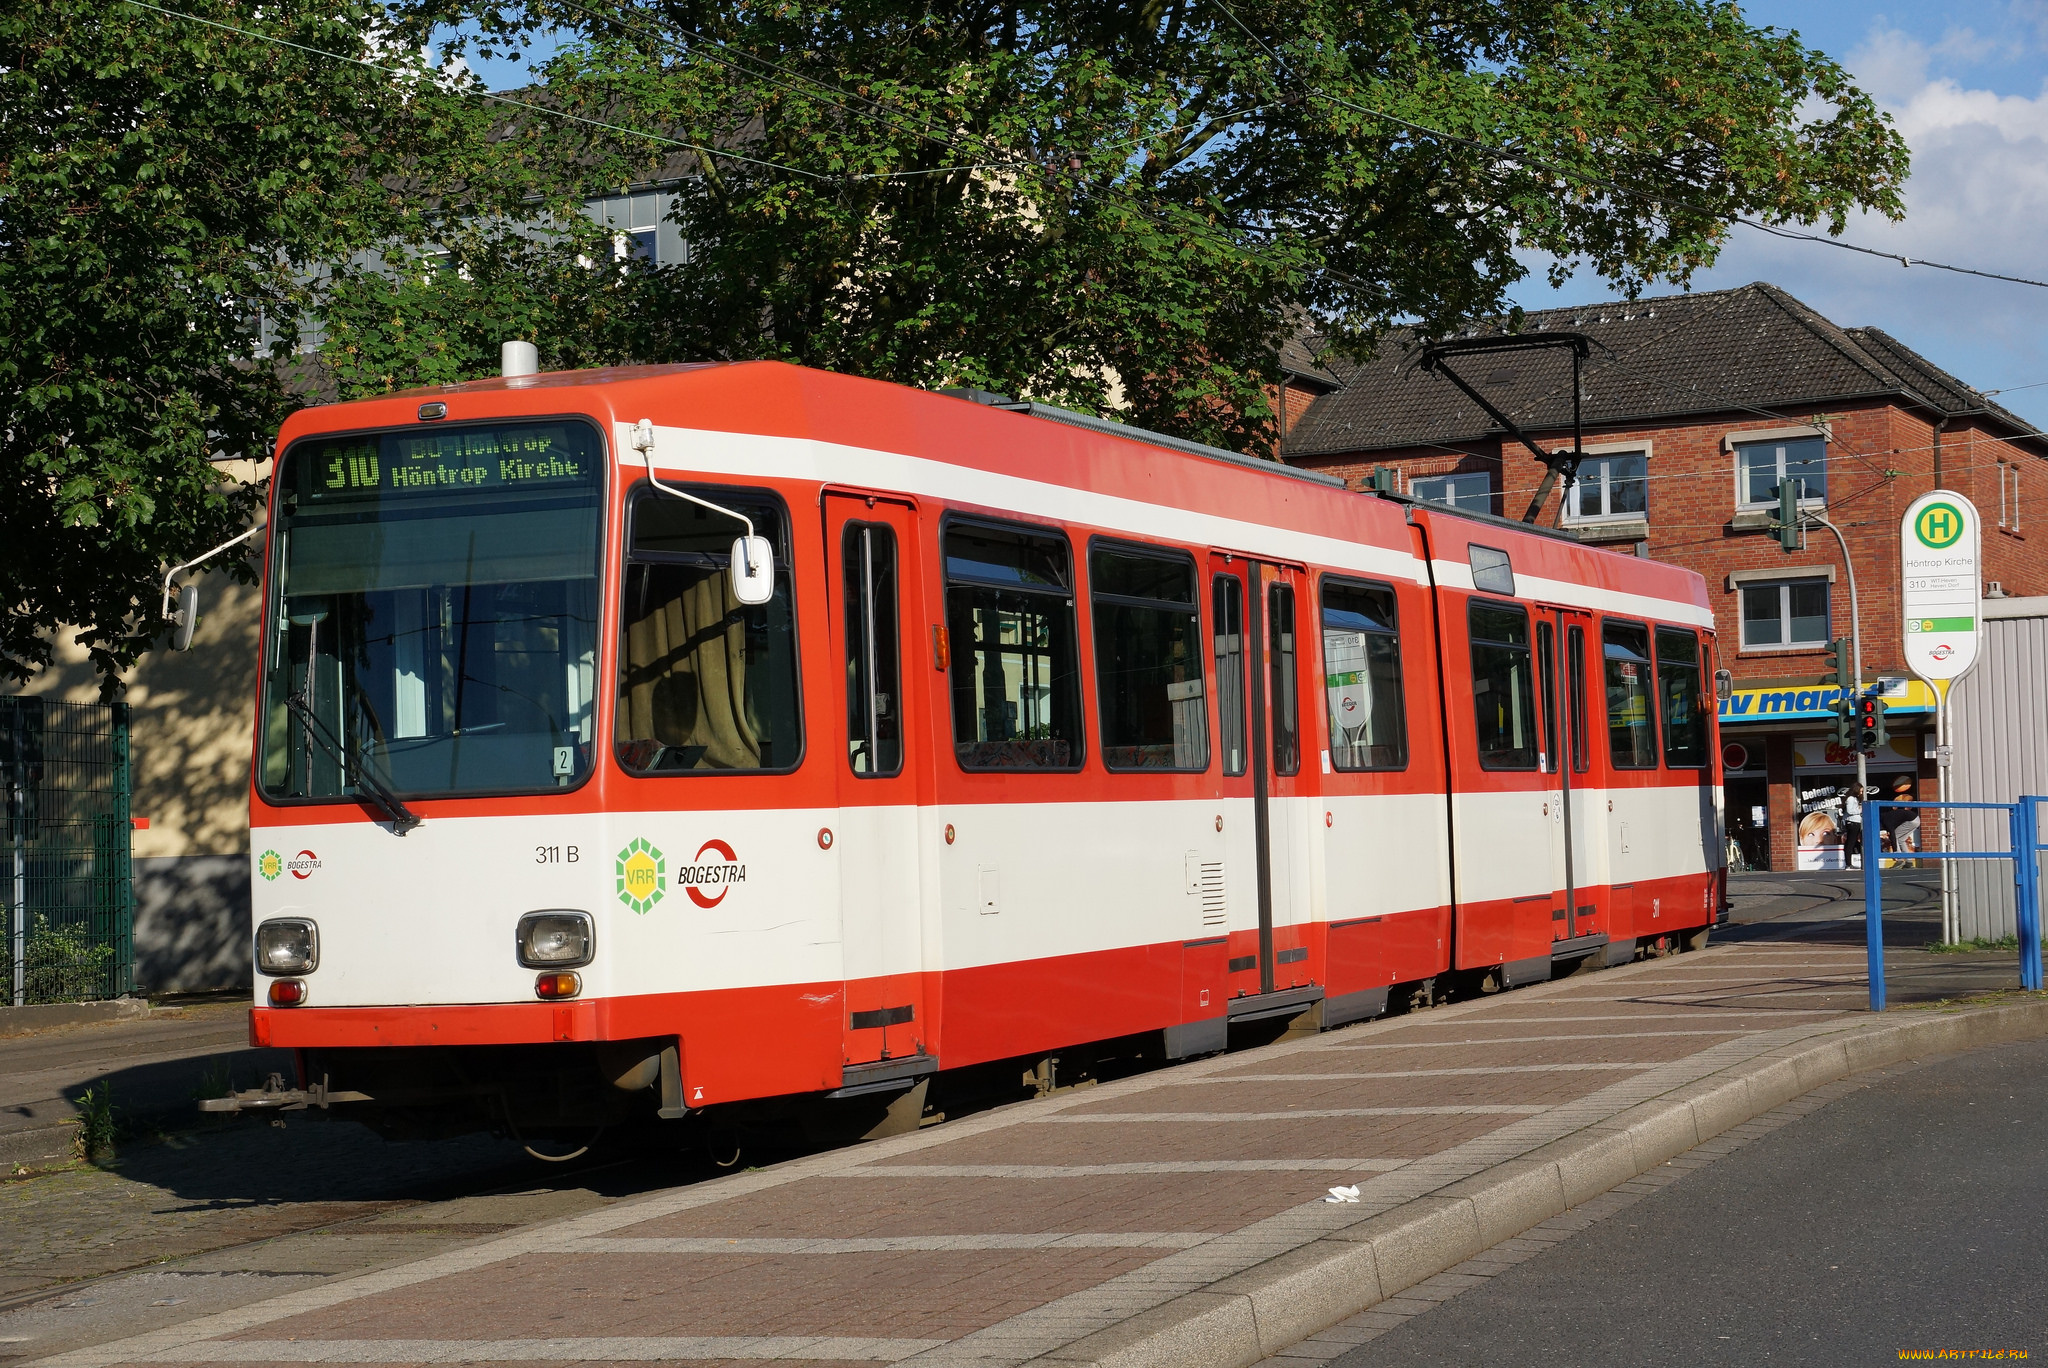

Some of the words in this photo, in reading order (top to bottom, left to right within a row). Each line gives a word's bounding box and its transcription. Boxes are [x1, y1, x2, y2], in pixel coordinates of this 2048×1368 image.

[323, 446, 380, 489] 310
[391, 464, 488, 488] Höntrop
[500, 456, 579, 480] Kirche
[1928, 513, 1950, 539] H
[1906, 559, 1942, 568] Höntrop
[1944, 557, 1973, 566] Kirche
[1909, 580, 1927, 589] 310
[560, 750, 568, 769] 2
[1802, 785, 1836, 801] Belegte
[1802, 796, 1842, 813] Brötchen
[535, 846, 560, 863] 311
[567, 846, 580, 863] B
[263, 862, 277, 870] VRR
[287, 860, 322, 870] BOGESTRA
[626, 868, 655, 885] VRR
[677, 864, 746, 885] BOGESTRA
[1652, 898, 1660, 919] 311
